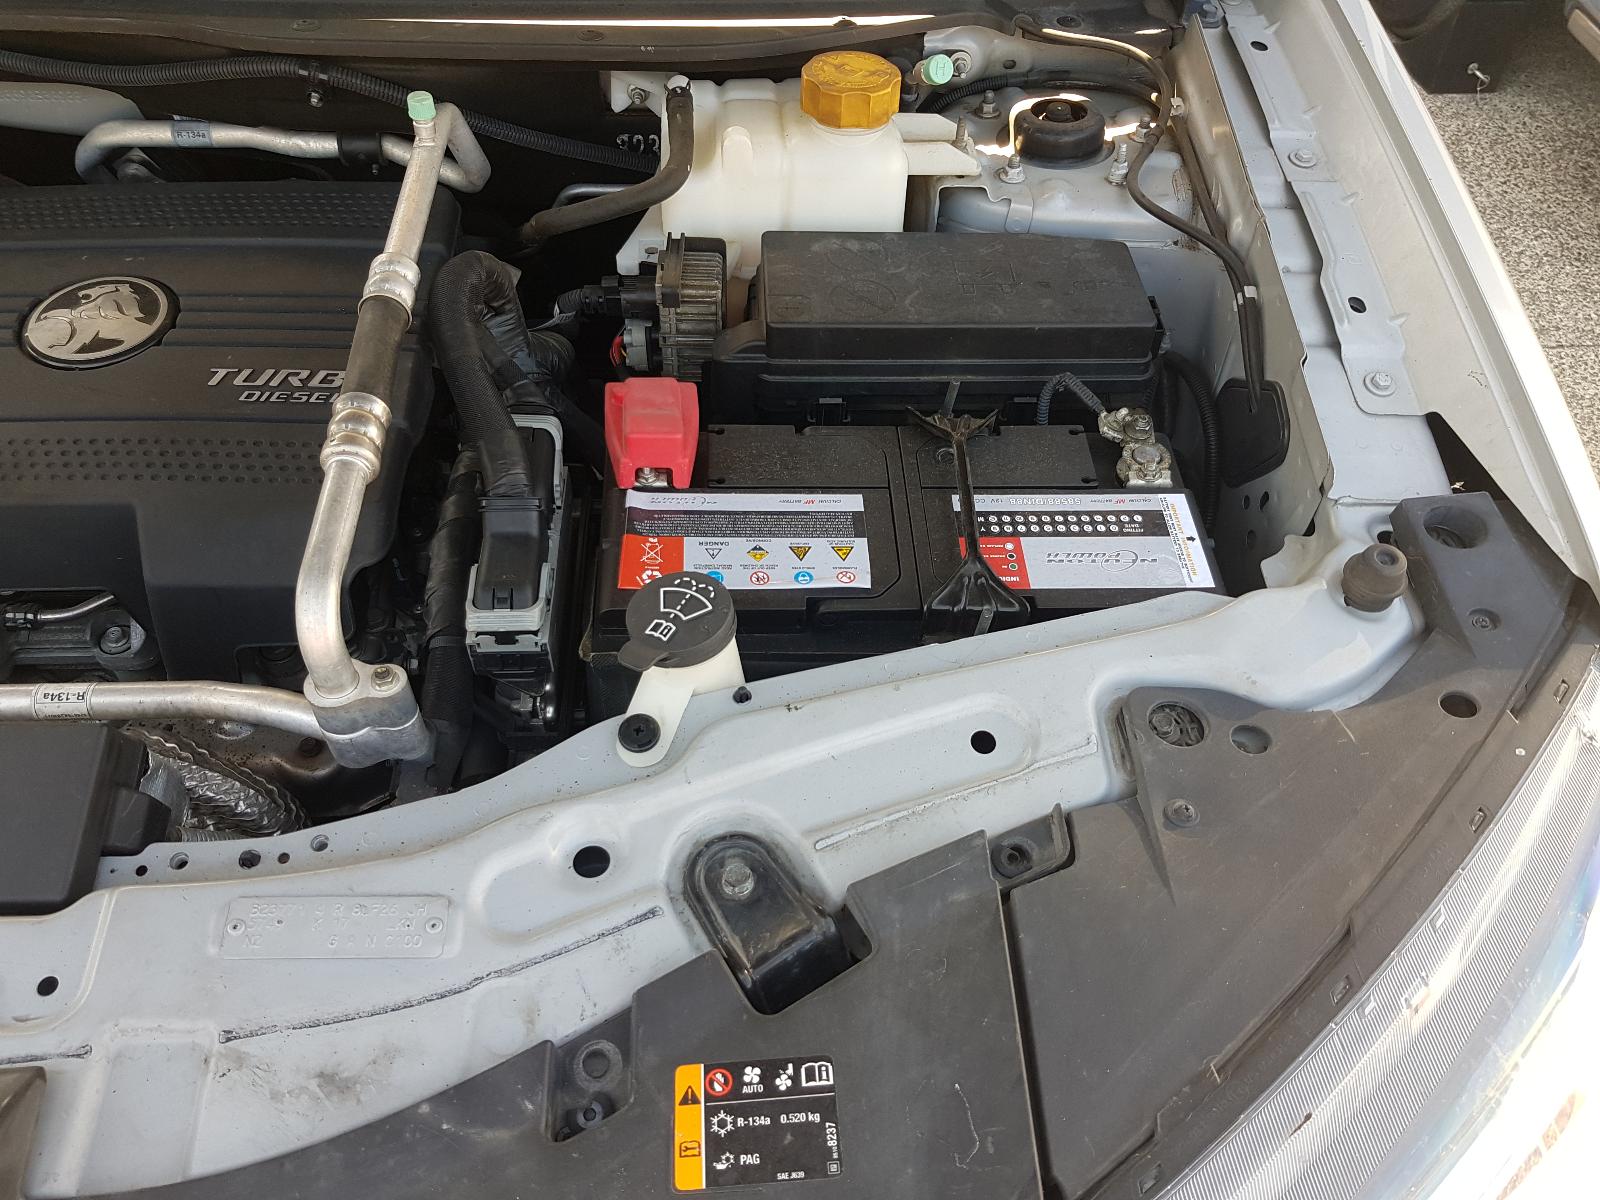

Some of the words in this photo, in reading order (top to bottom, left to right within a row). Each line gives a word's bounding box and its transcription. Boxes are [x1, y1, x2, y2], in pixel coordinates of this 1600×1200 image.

[207, 368, 346, 388] TURB
[43, 692, 86, 702] R-134a
[742, 1085, 763, 1093] AUTO
[737, 1117, 771, 1127] R-134a
[780, 1113, 805, 1123] 0.520
[808, 1112, 820, 1123] kg
[740, 1154, 760, 1165] PAG
